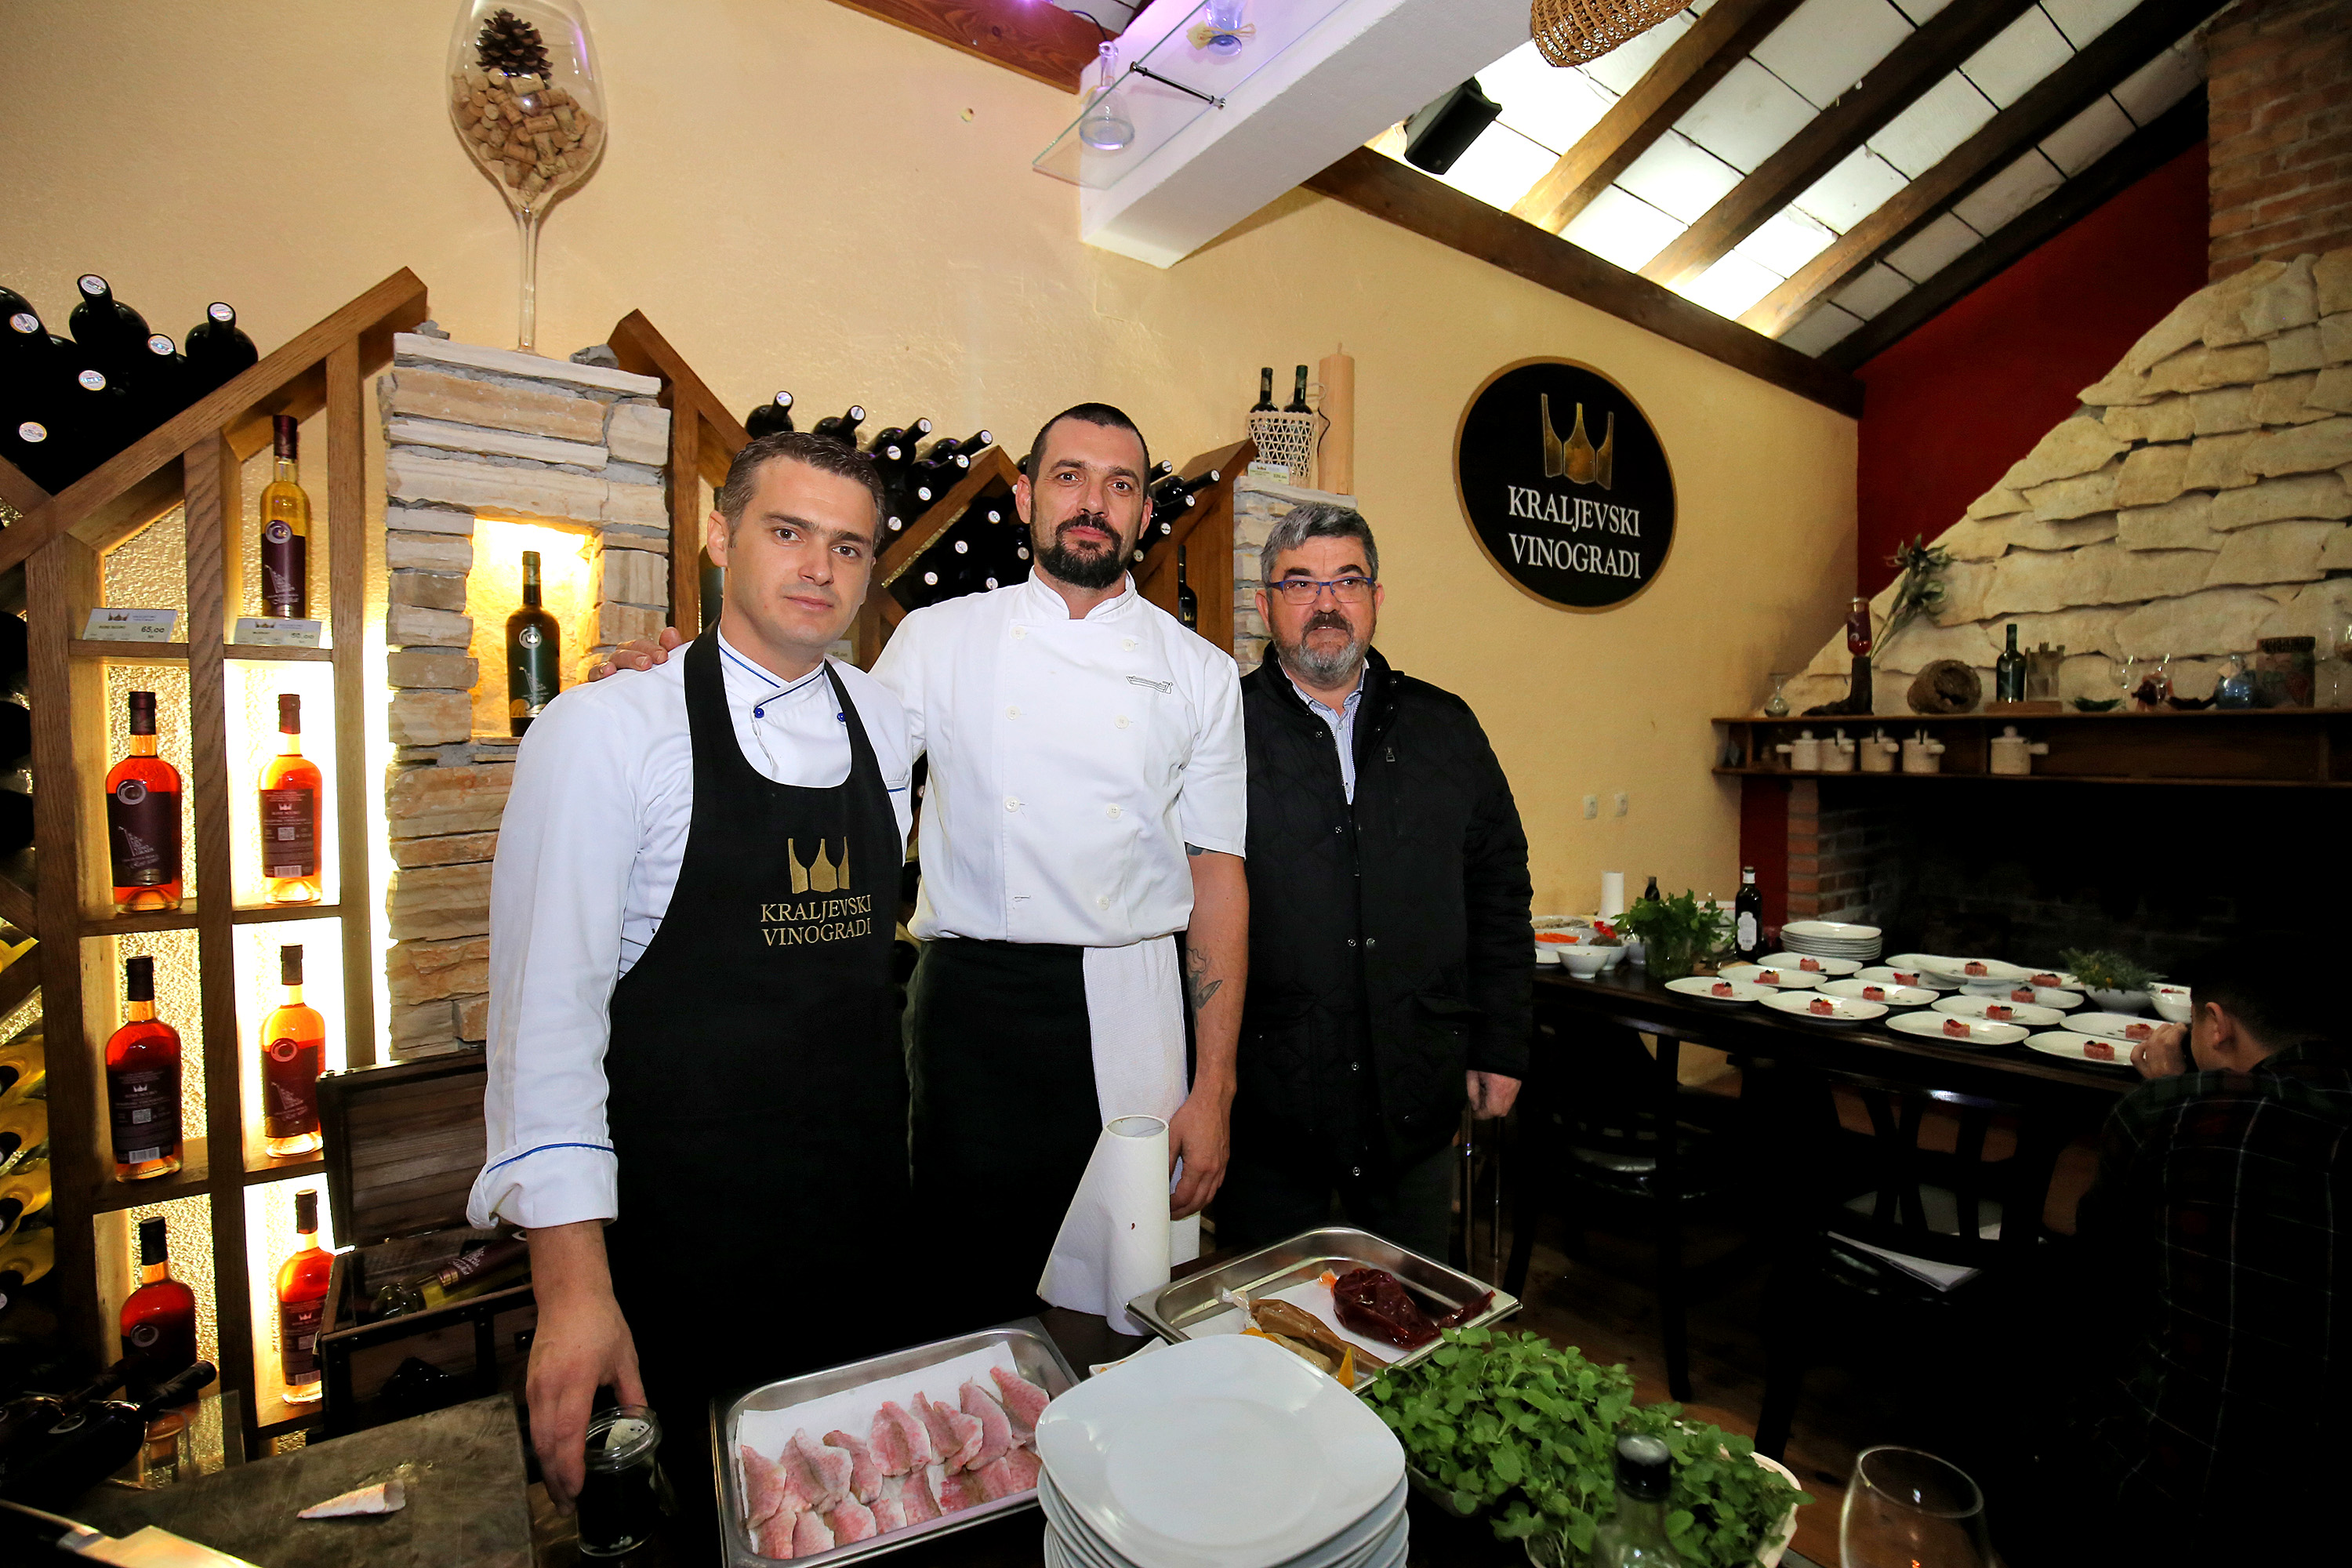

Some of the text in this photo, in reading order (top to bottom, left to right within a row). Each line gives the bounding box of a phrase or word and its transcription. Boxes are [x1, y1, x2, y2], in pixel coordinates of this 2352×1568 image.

[1508, 485, 1641, 537] KRALJEVSKI
[1508, 533, 1642, 579] VINOGRADI
[760, 895, 872, 924] KRALJEVSKI
[761, 917, 872, 946] VINOGRADI
